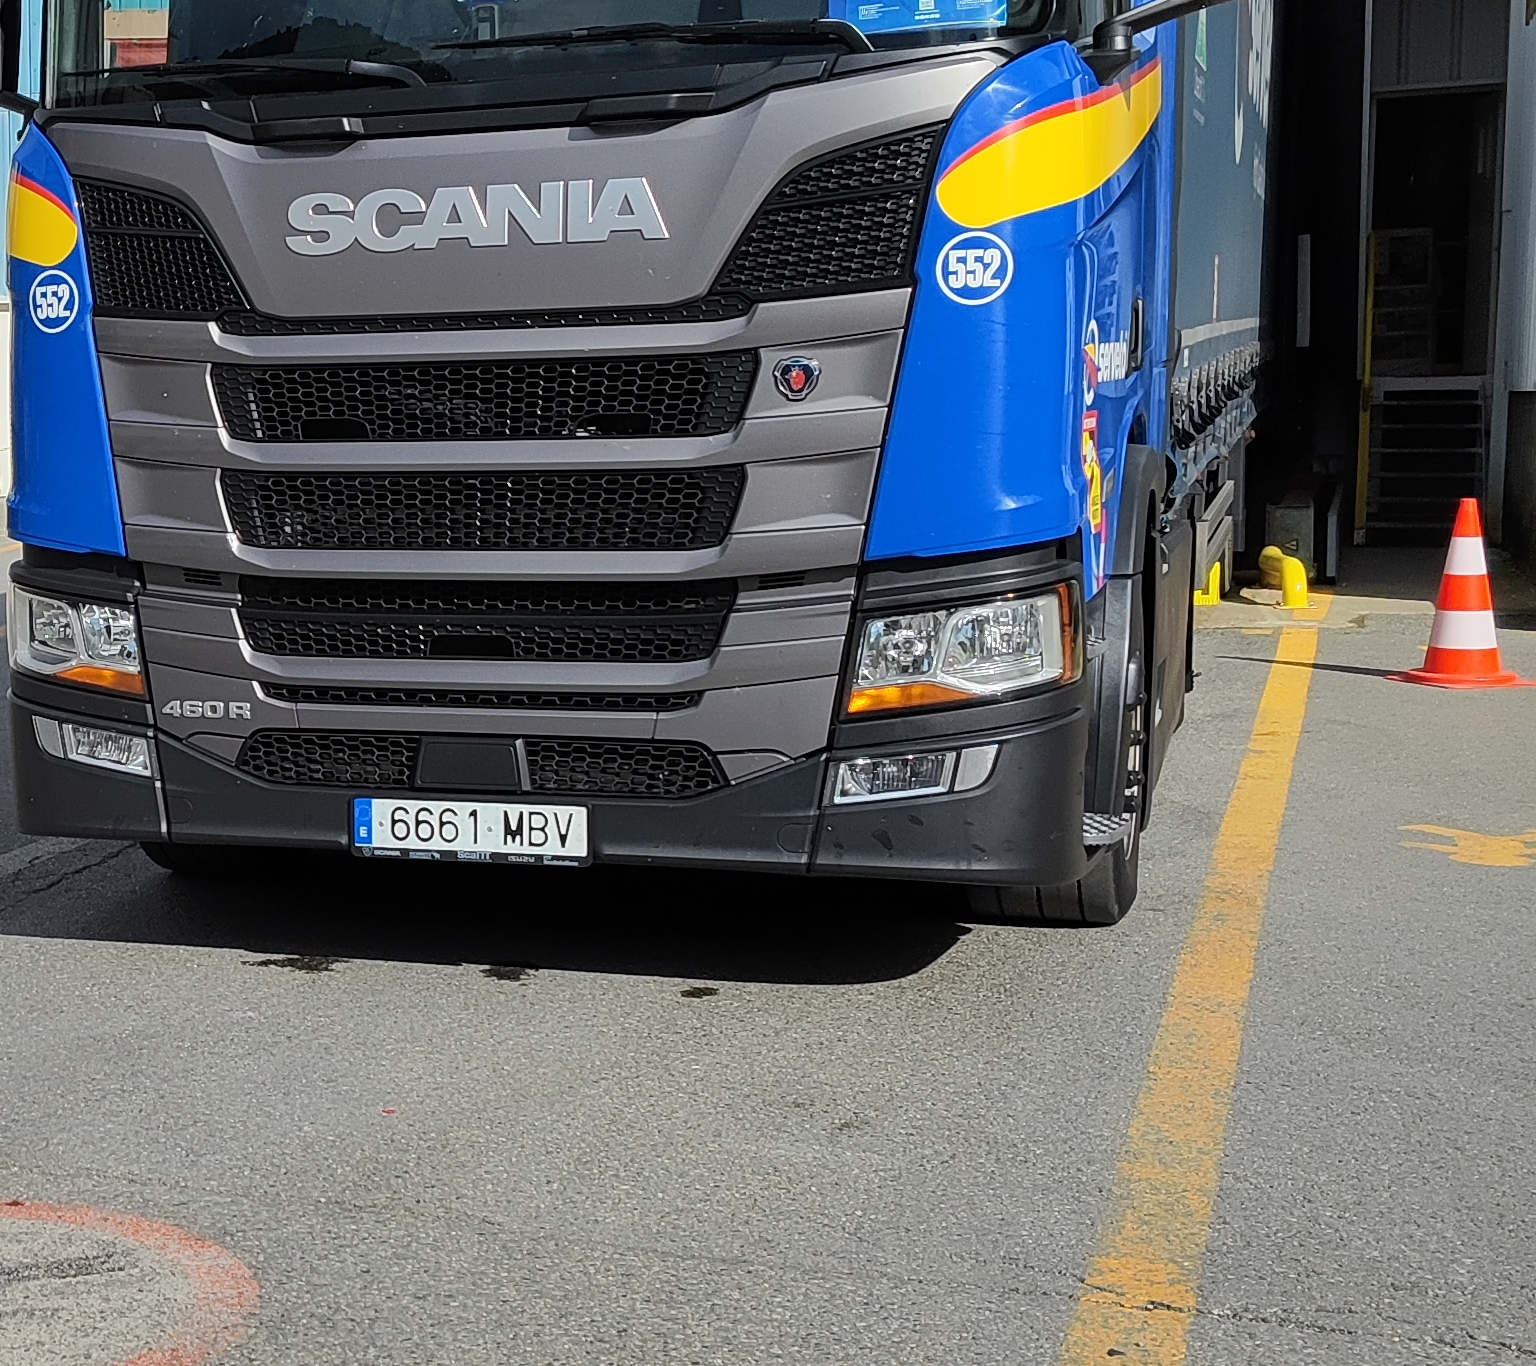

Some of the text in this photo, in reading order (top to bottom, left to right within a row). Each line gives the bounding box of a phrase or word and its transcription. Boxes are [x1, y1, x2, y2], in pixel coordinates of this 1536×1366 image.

[285, 176, 670, 256] SCANIA
[947, 248, 1003, 290] 552
[35, 283, 72, 321] 552
[161, 699, 252, 721] 460 R
[359, 826, 368, 838] E
[390, 805, 574, 849] 6661 MBV
